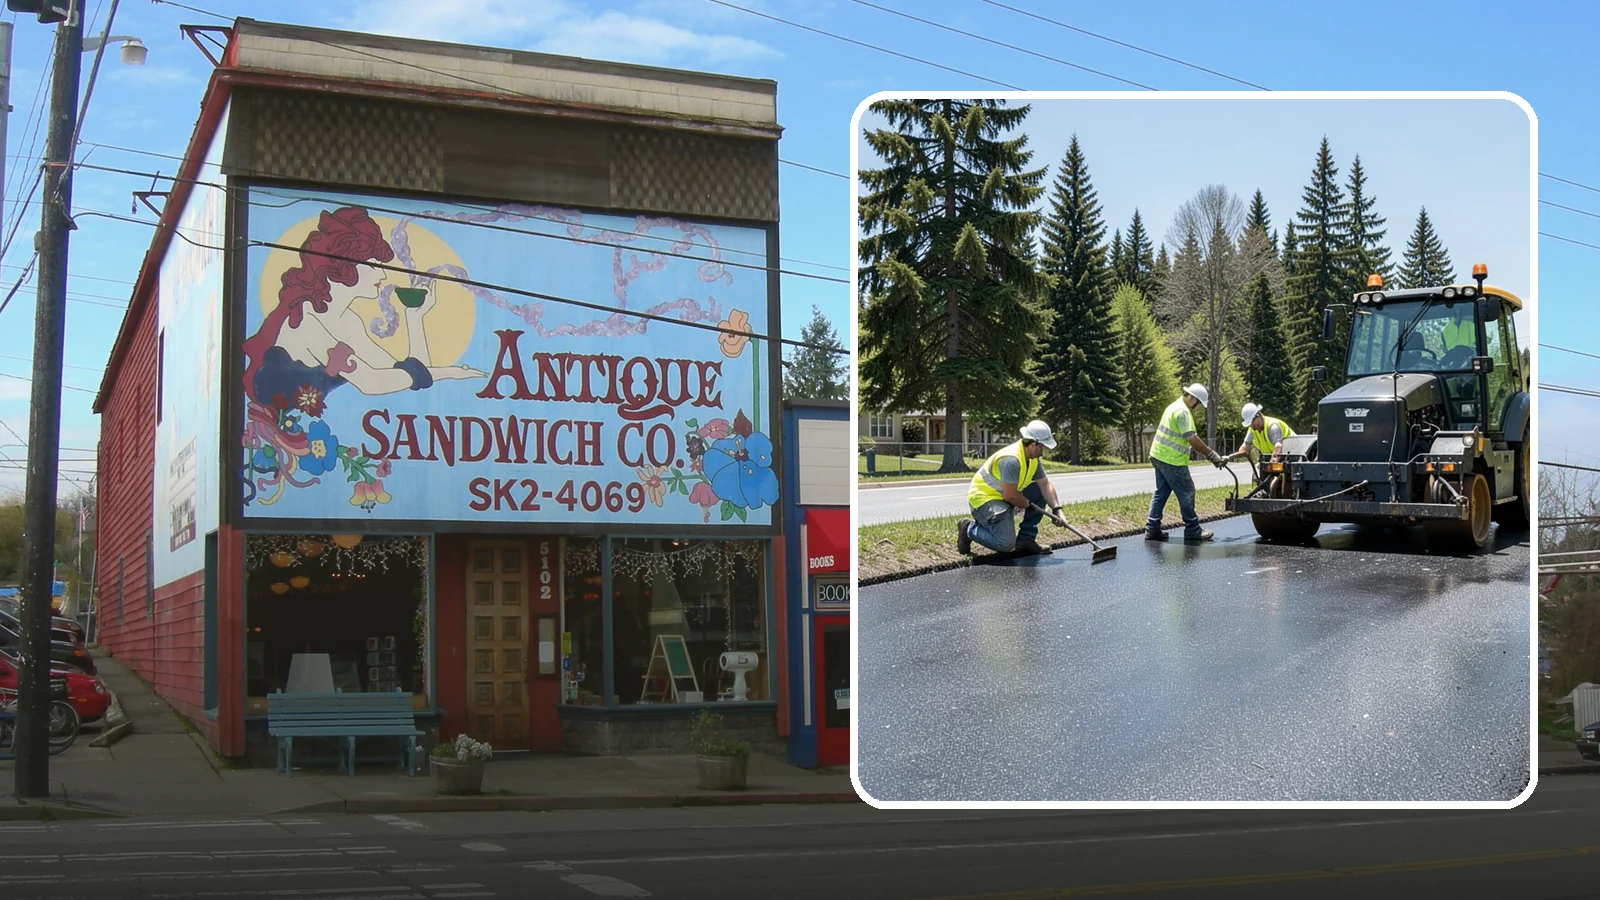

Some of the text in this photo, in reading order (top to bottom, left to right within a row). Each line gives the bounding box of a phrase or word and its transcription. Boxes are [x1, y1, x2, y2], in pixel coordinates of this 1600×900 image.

[475, 328, 723, 420] ANTIQUE
[361, 408, 685, 468] SANDWICH CO.
[468, 477, 646, 513] SK2-4069
[540, 541, 551, 600] 5102
[809, 555, 835, 569] BOOKS
